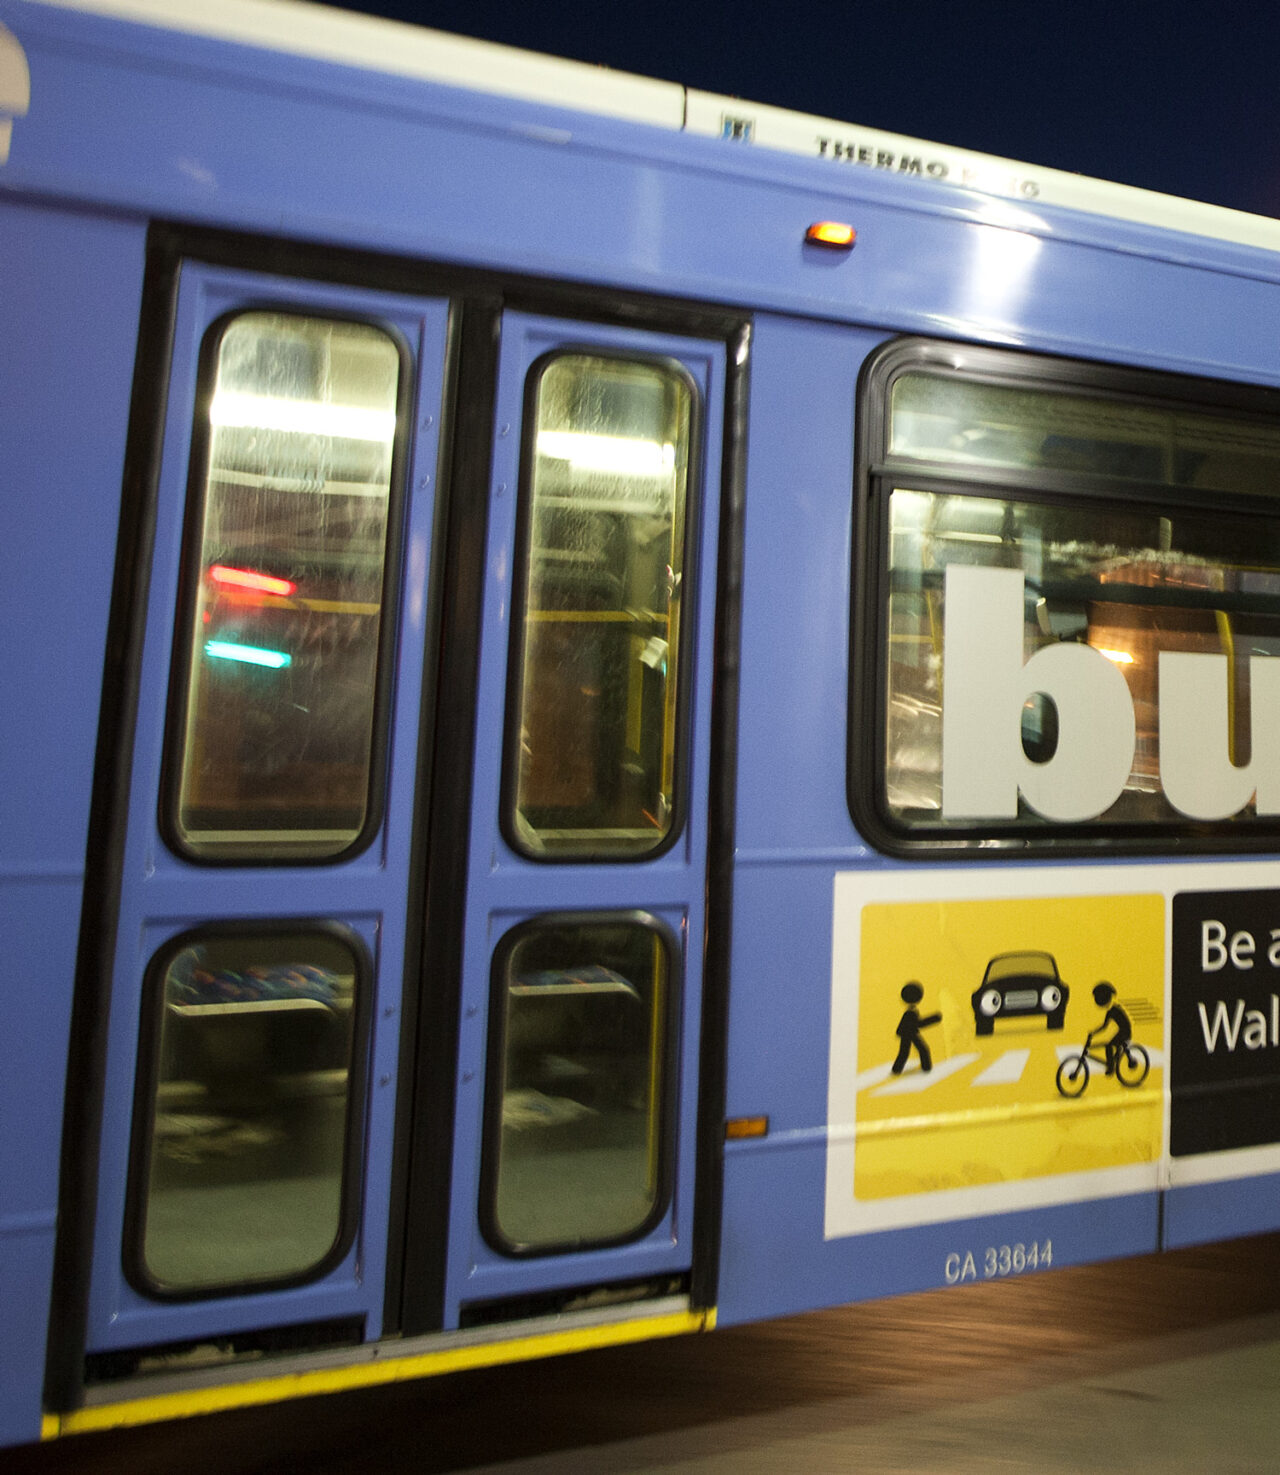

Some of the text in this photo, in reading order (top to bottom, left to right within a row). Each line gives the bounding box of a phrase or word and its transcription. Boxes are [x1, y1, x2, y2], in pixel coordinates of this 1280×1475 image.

[815, 135, 949, 180] THERMO
[1200, 920, 1256, 972] Be
[945, 1239, 1053, 1284] CA 33644
